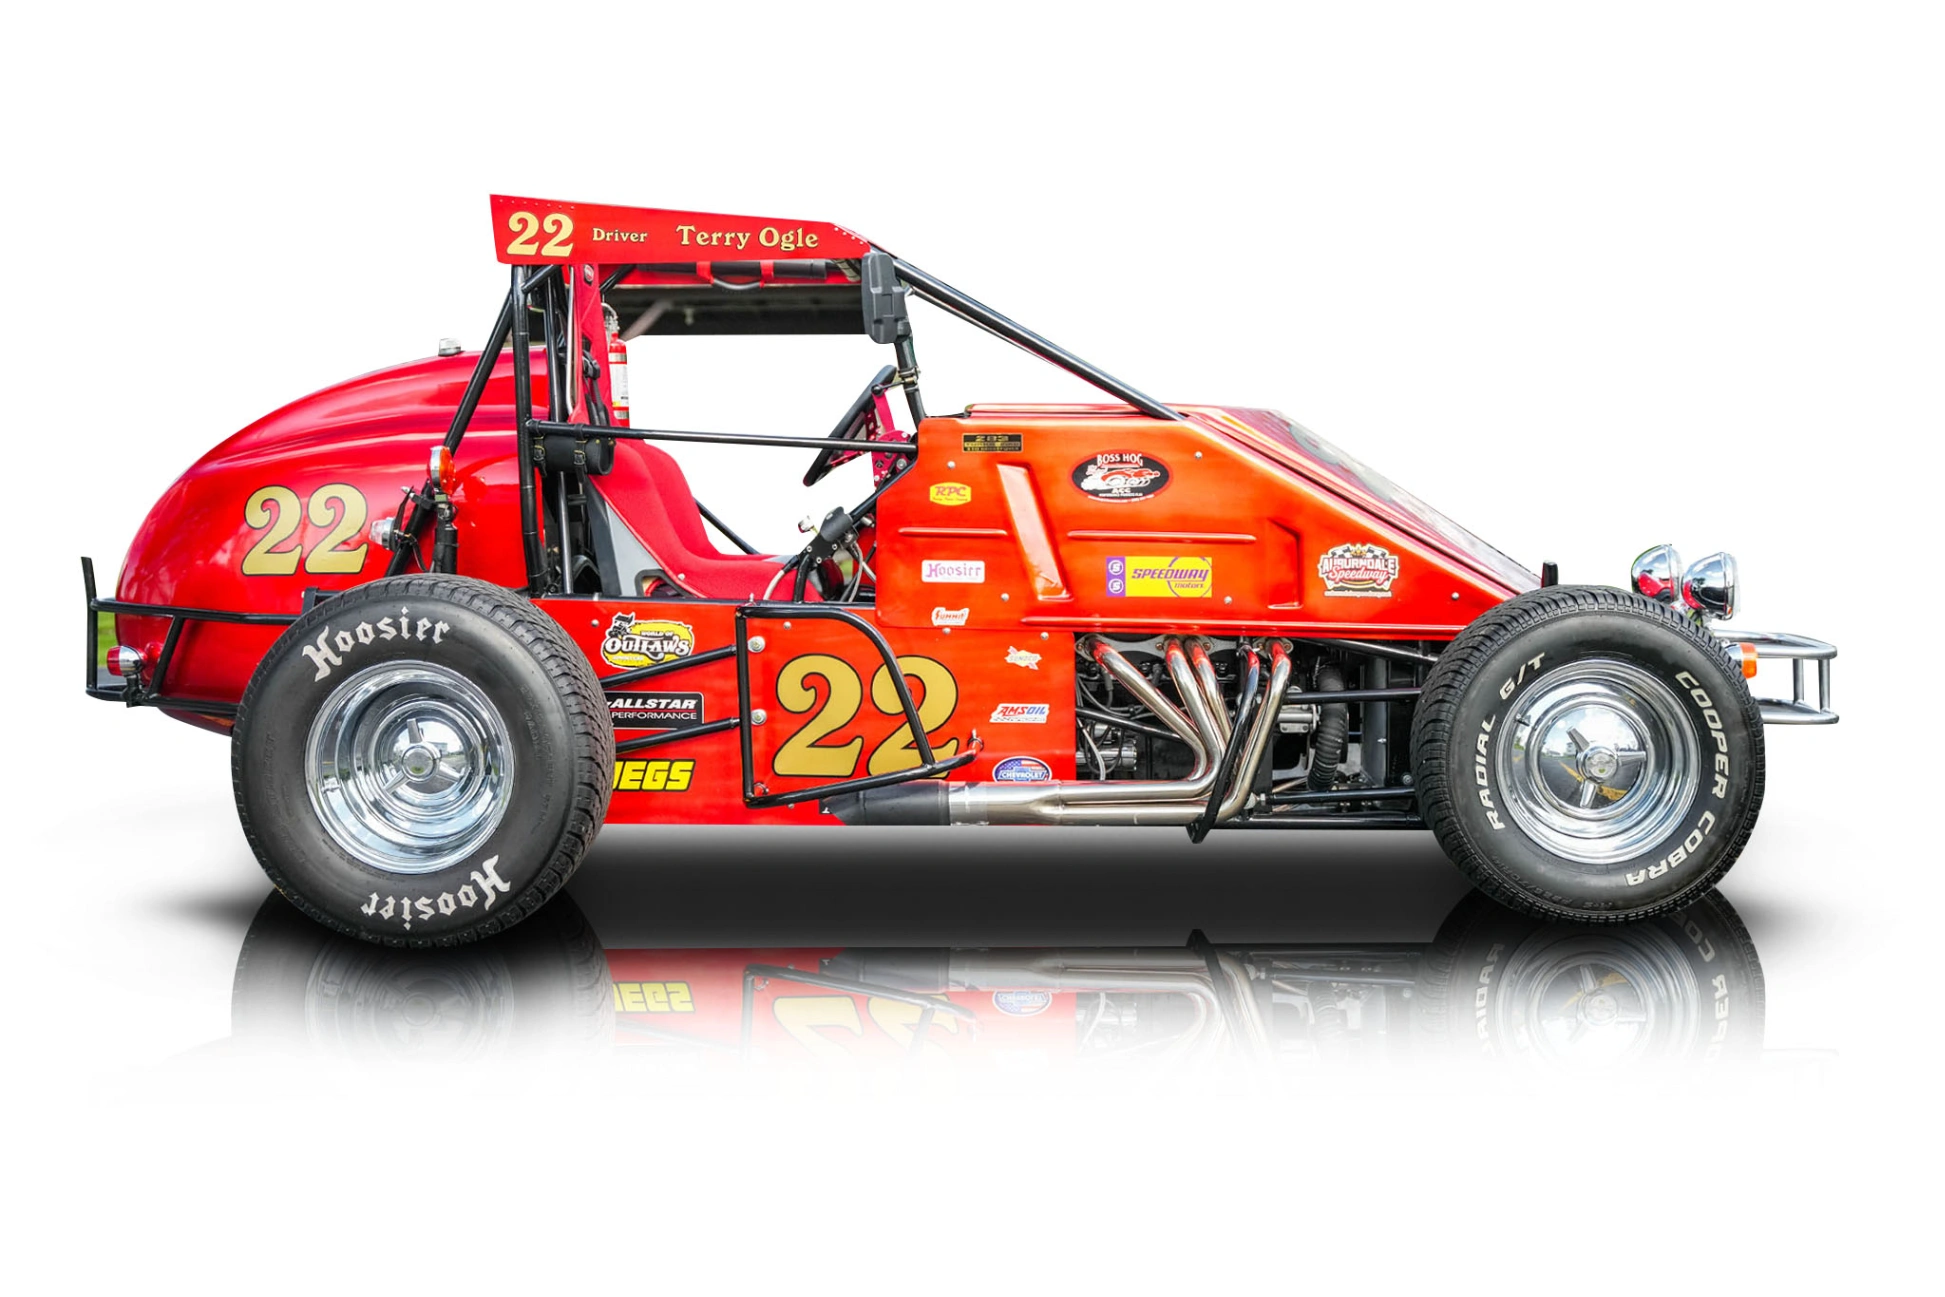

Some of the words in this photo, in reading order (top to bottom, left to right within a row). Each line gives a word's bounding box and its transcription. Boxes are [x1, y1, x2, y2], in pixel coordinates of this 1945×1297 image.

[506, 211, 575, 257] 22
[592, 227, 648, 243] Driver
[675, 225, 751, 250] Terry
[758, 226, 819, 252] Ogle
[1097, 453, 1120, 466] BOSS
[1122, 453, 1143, 466] HOG
[935, 485, 967, 497] RPC
[241, 482, 369, 577] 22
[925, 562, 981, 578] Hoosier
[1131, 569, 1209, 582] SPEEDWAY
[1322, 557, 1396, 574] AUBURNDALE
[1328, 565, 1389, 585] Speedway
[302, 606, 450, 682] Hoosier
[610, 698, 698, 709] ALLSTAR
[998, 706, 1046, 717] AMSOIL
[611, 711, 697, 720] PERFORMANCE
[772, 653, 960, 779] 22
[1475, 714, 1505, 830] RADIAL
[1499, 652, 1545, 700] G/T
[1675, 670, 1730, 799] COOPER
[1625, 810, 1716, 887] COBRA
[361, 854, 511, 930] Hoosier
